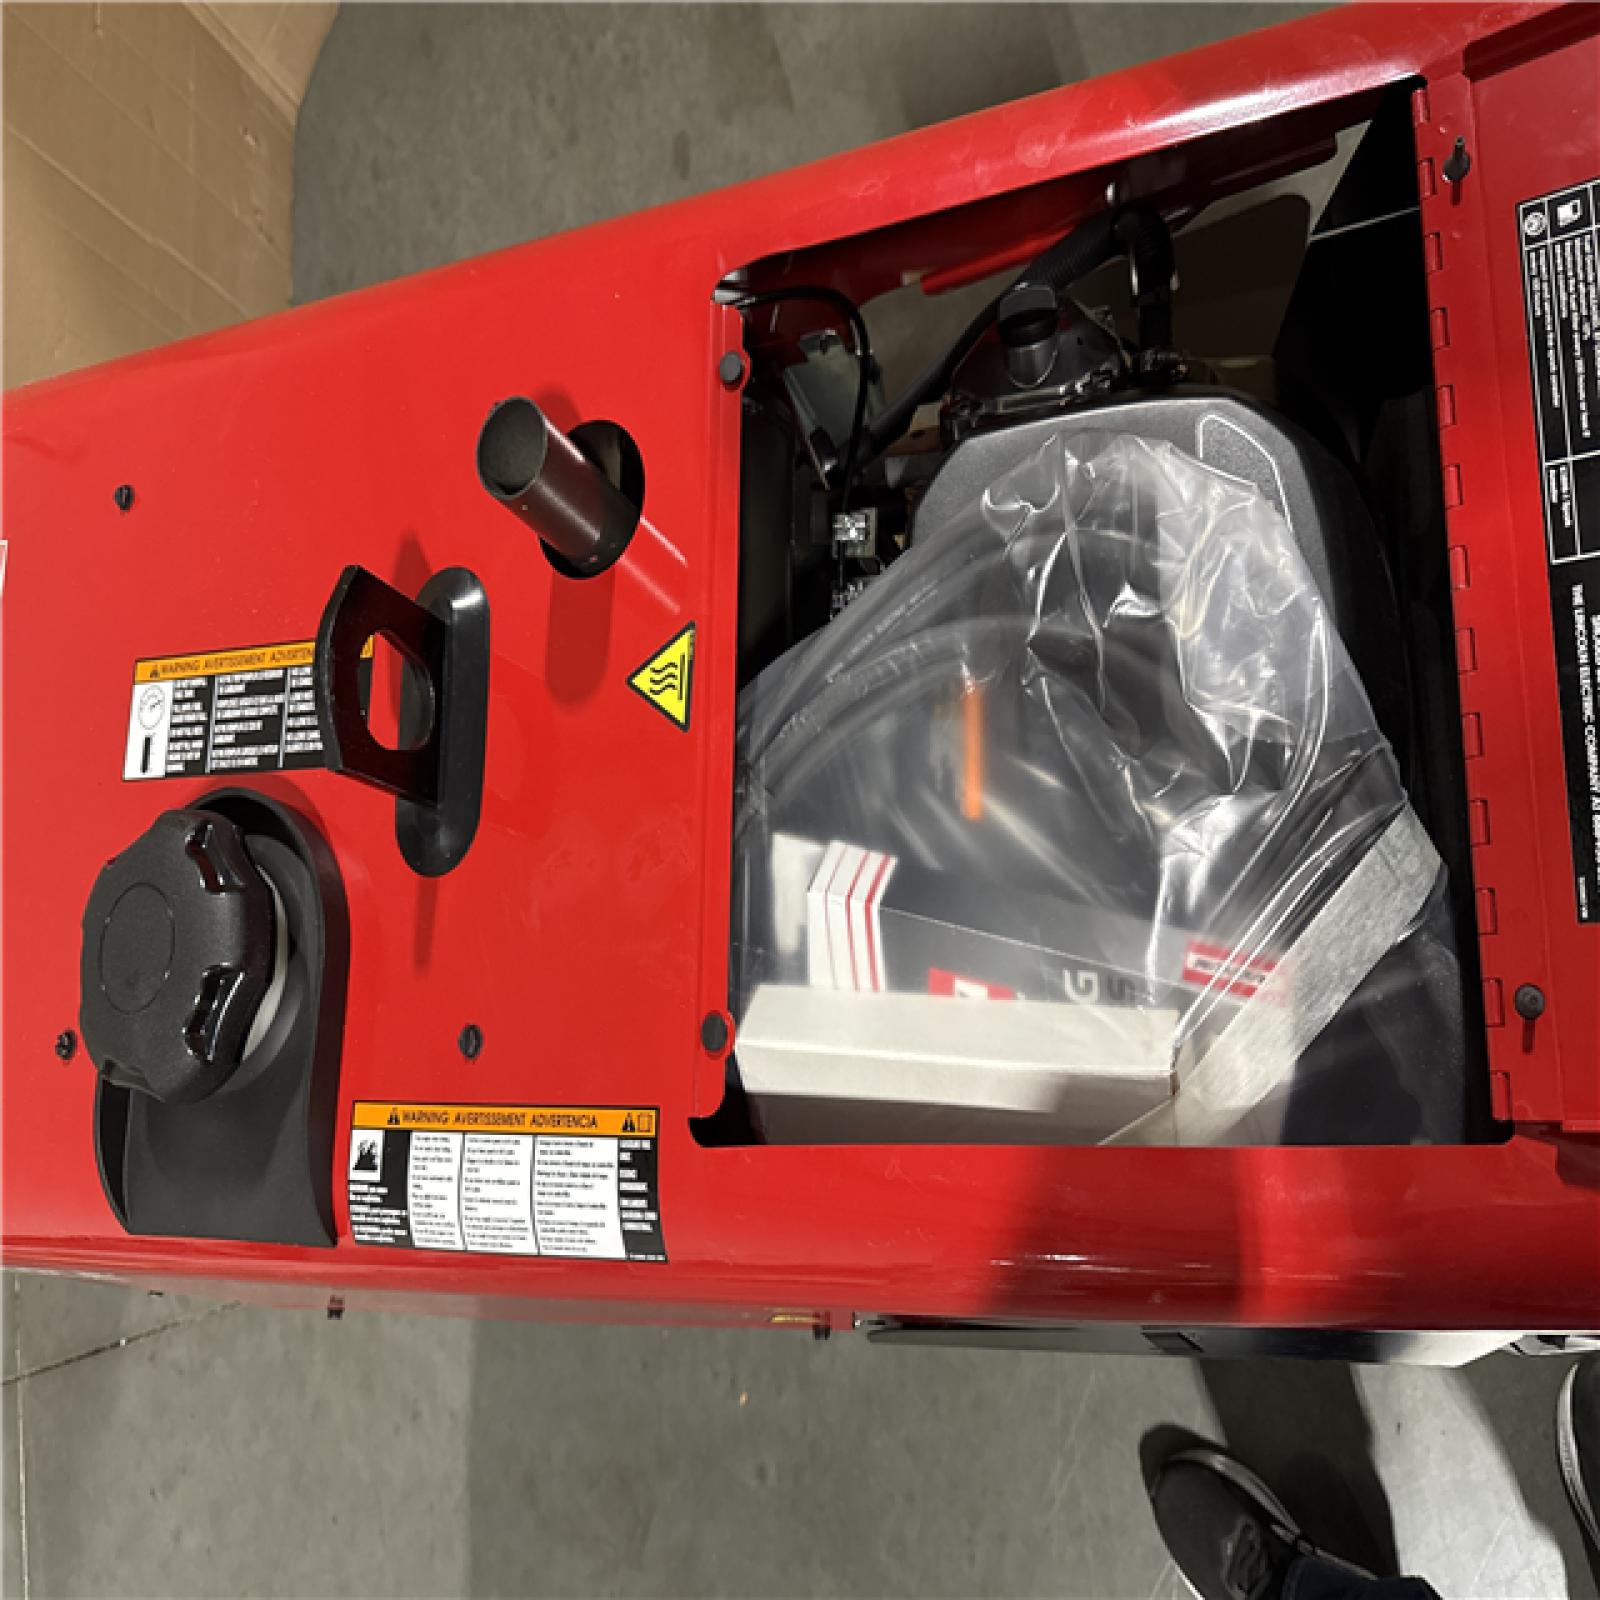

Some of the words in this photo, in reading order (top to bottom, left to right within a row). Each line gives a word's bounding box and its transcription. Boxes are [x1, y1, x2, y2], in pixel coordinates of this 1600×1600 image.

[1574, 608, 1588, 663] LINCOLN
[161, 660, 201, 674] WARNING
[402, 1110, 449, 1125] WARNING
[454, 1111, 526, 1127] AVERTISSEMENT
[530, 1113, 598, 1129] ADVERTENCIA
